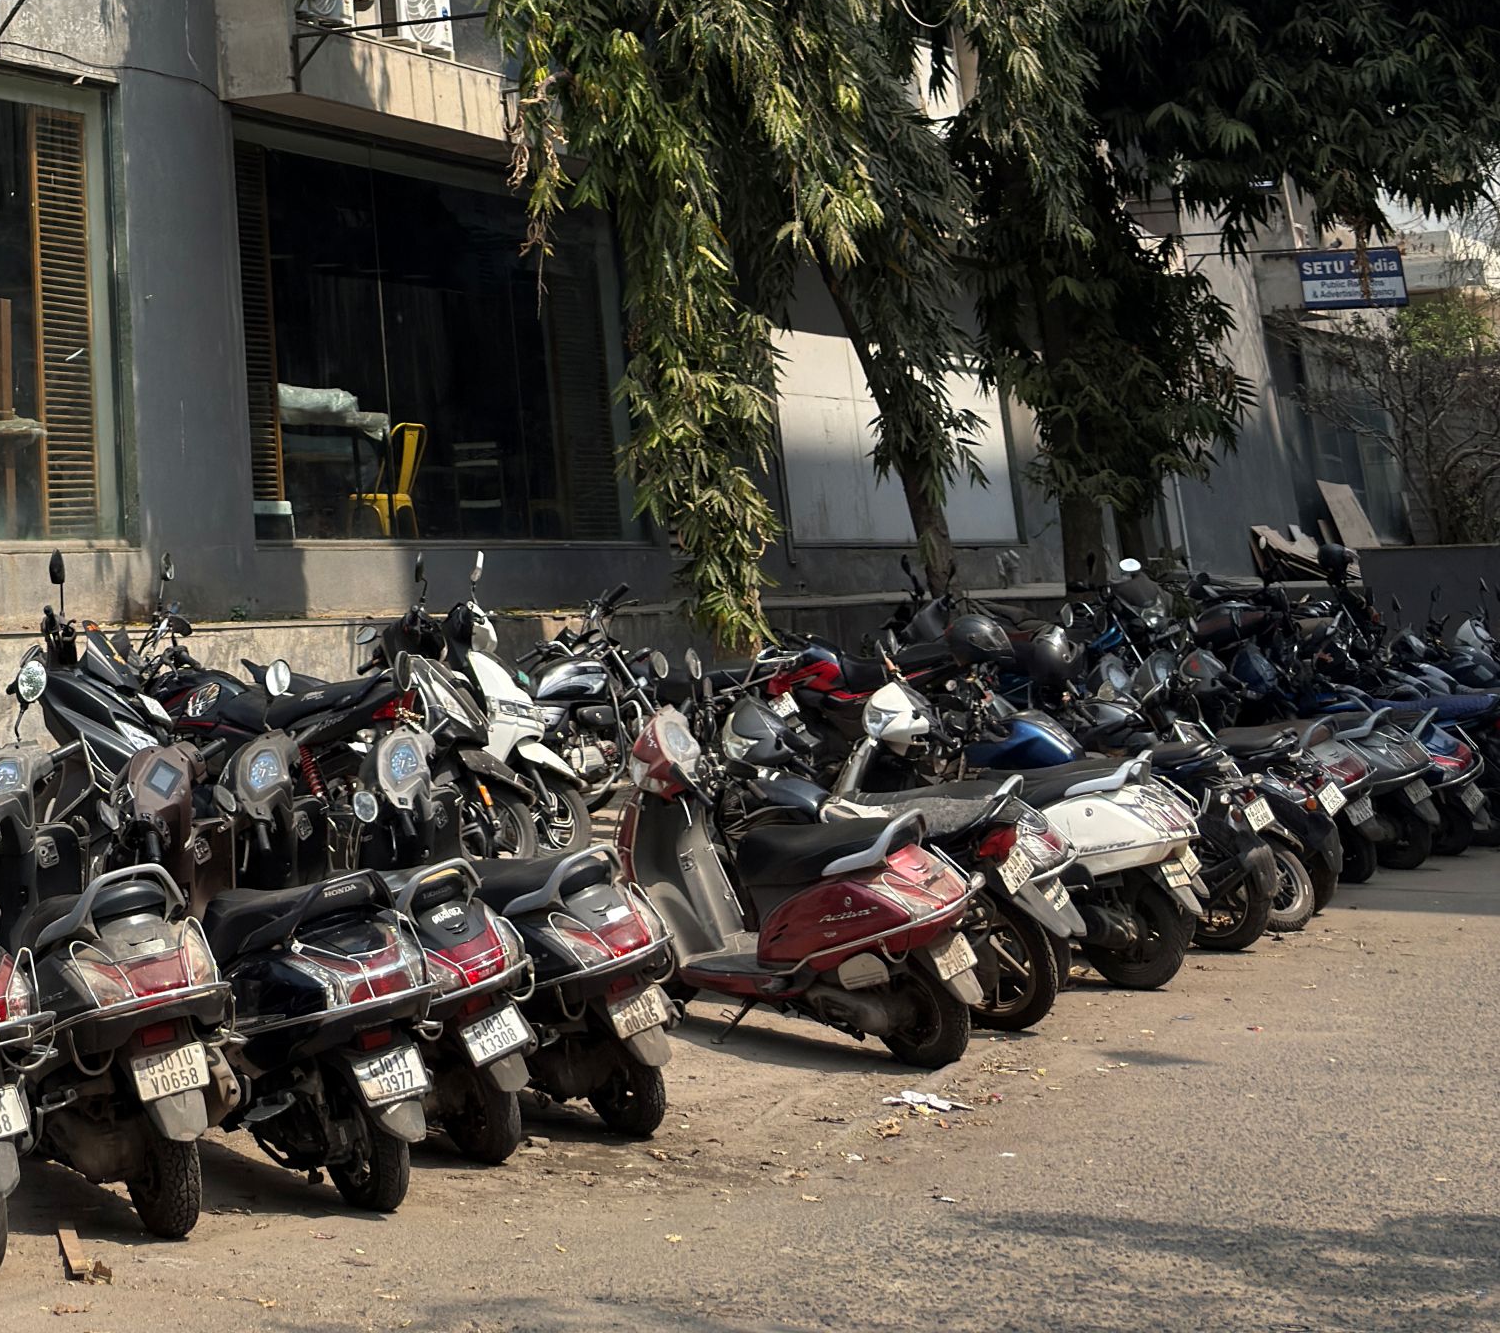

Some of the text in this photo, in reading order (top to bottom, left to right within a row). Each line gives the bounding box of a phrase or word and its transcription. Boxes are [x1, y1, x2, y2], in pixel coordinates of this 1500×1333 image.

[1302, 258, 1398, 275] SETU dia
[1348, 279, 1385, 288] Relons
[324, 884, 356, 897] HONDA
[472, 1013, 510, 1039] GJ03L
[147, 1048, 193, 1075] GJ01U
[368, 1052, 408, 1077] GJ01Y
[151, 1068, 198, 1094] V0658
[377, 1070, 413, 1094] J3977
